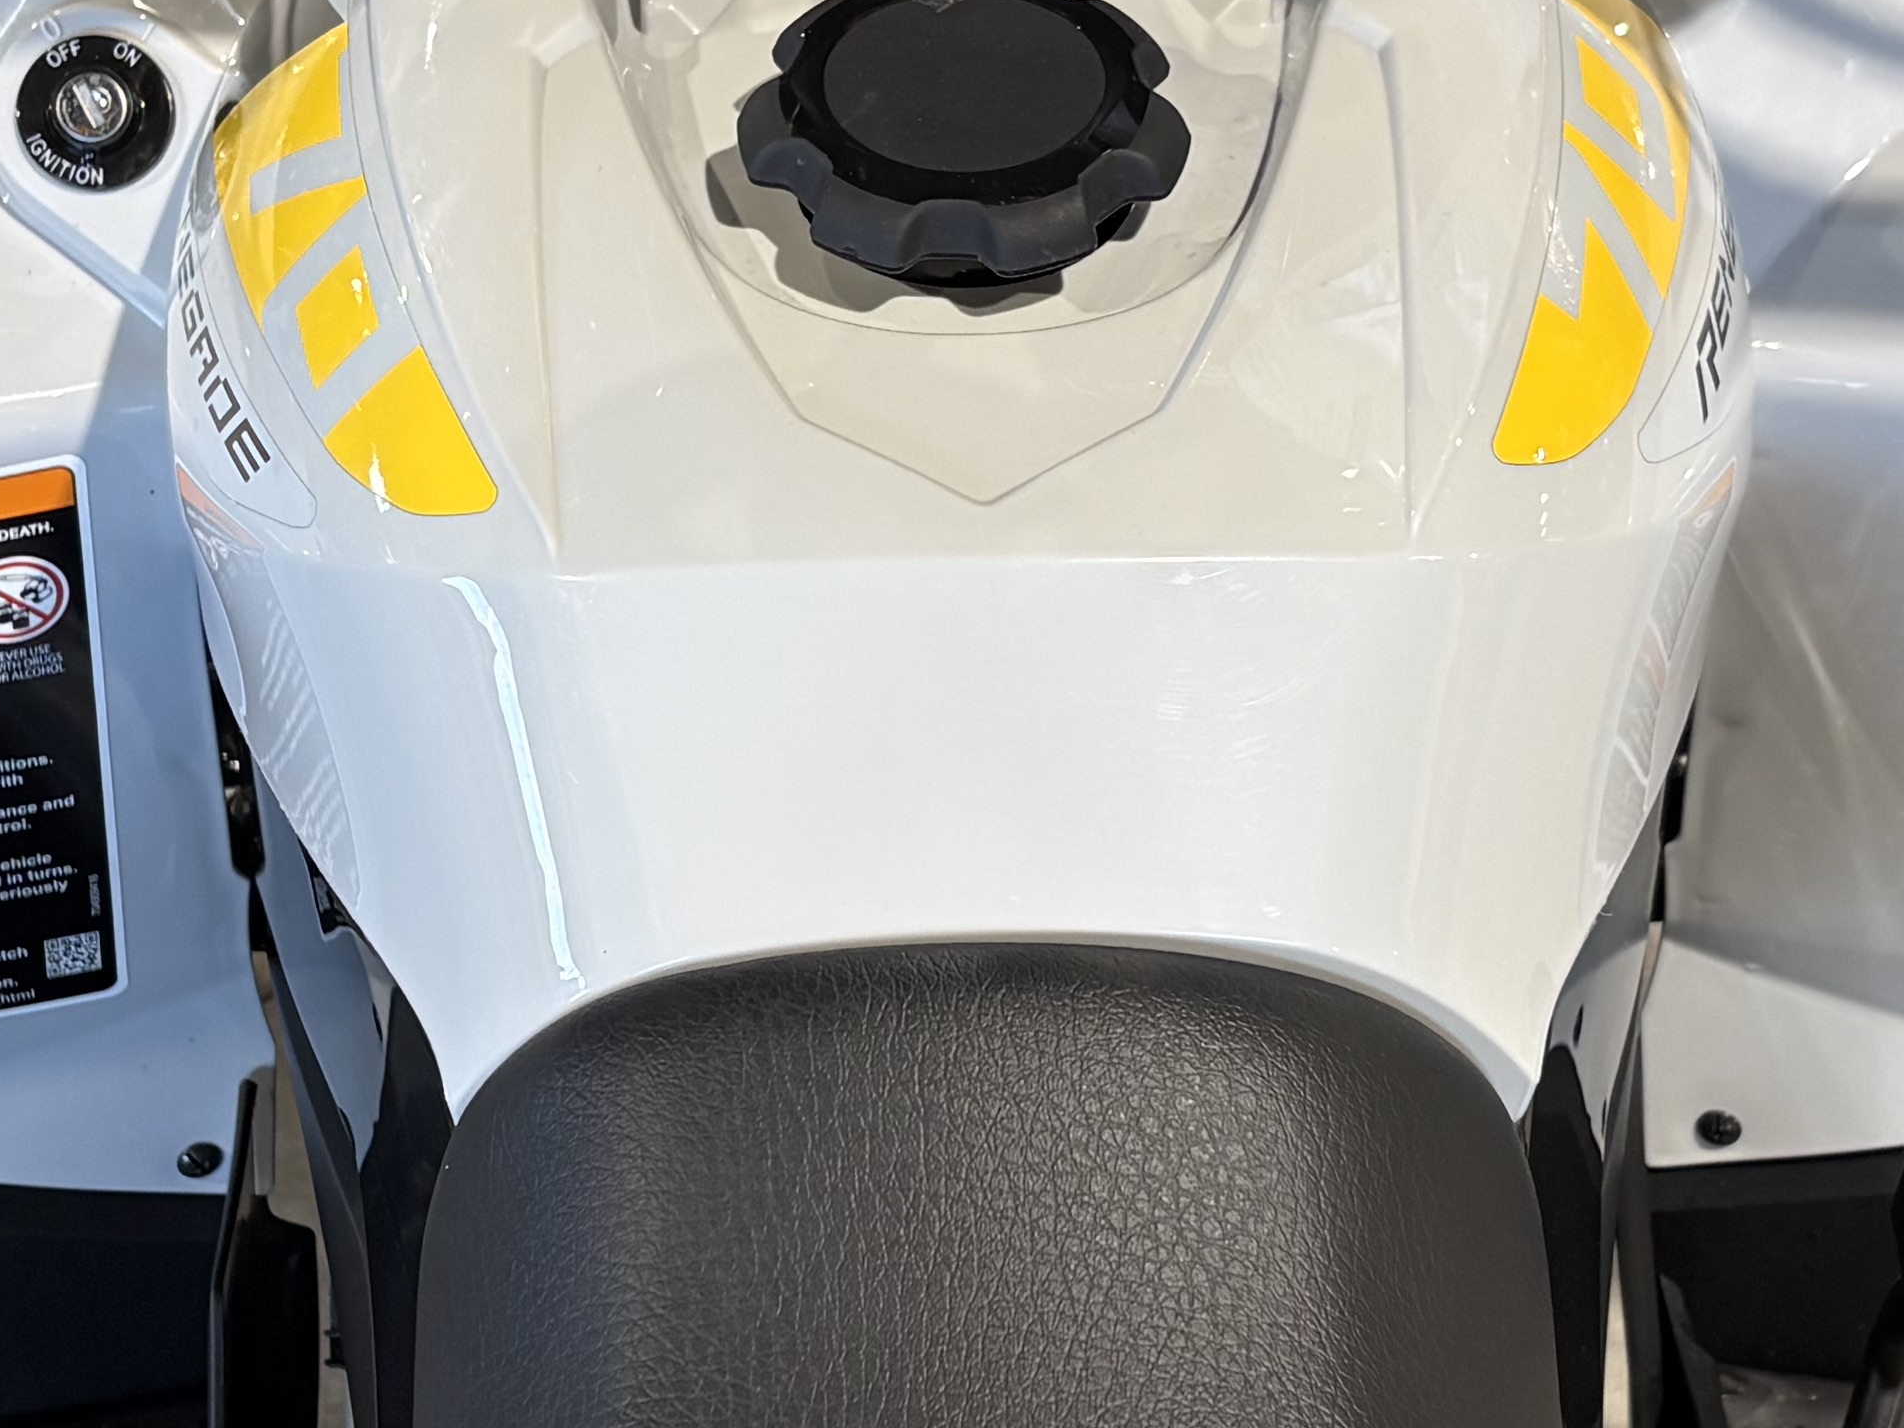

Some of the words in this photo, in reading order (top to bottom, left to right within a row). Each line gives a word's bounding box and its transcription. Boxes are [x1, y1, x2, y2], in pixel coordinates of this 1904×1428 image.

[46, 39, 81, 68] OFF
[113, 41, 142, 67] ON
[26, 133, 104, 186] IGNITION
